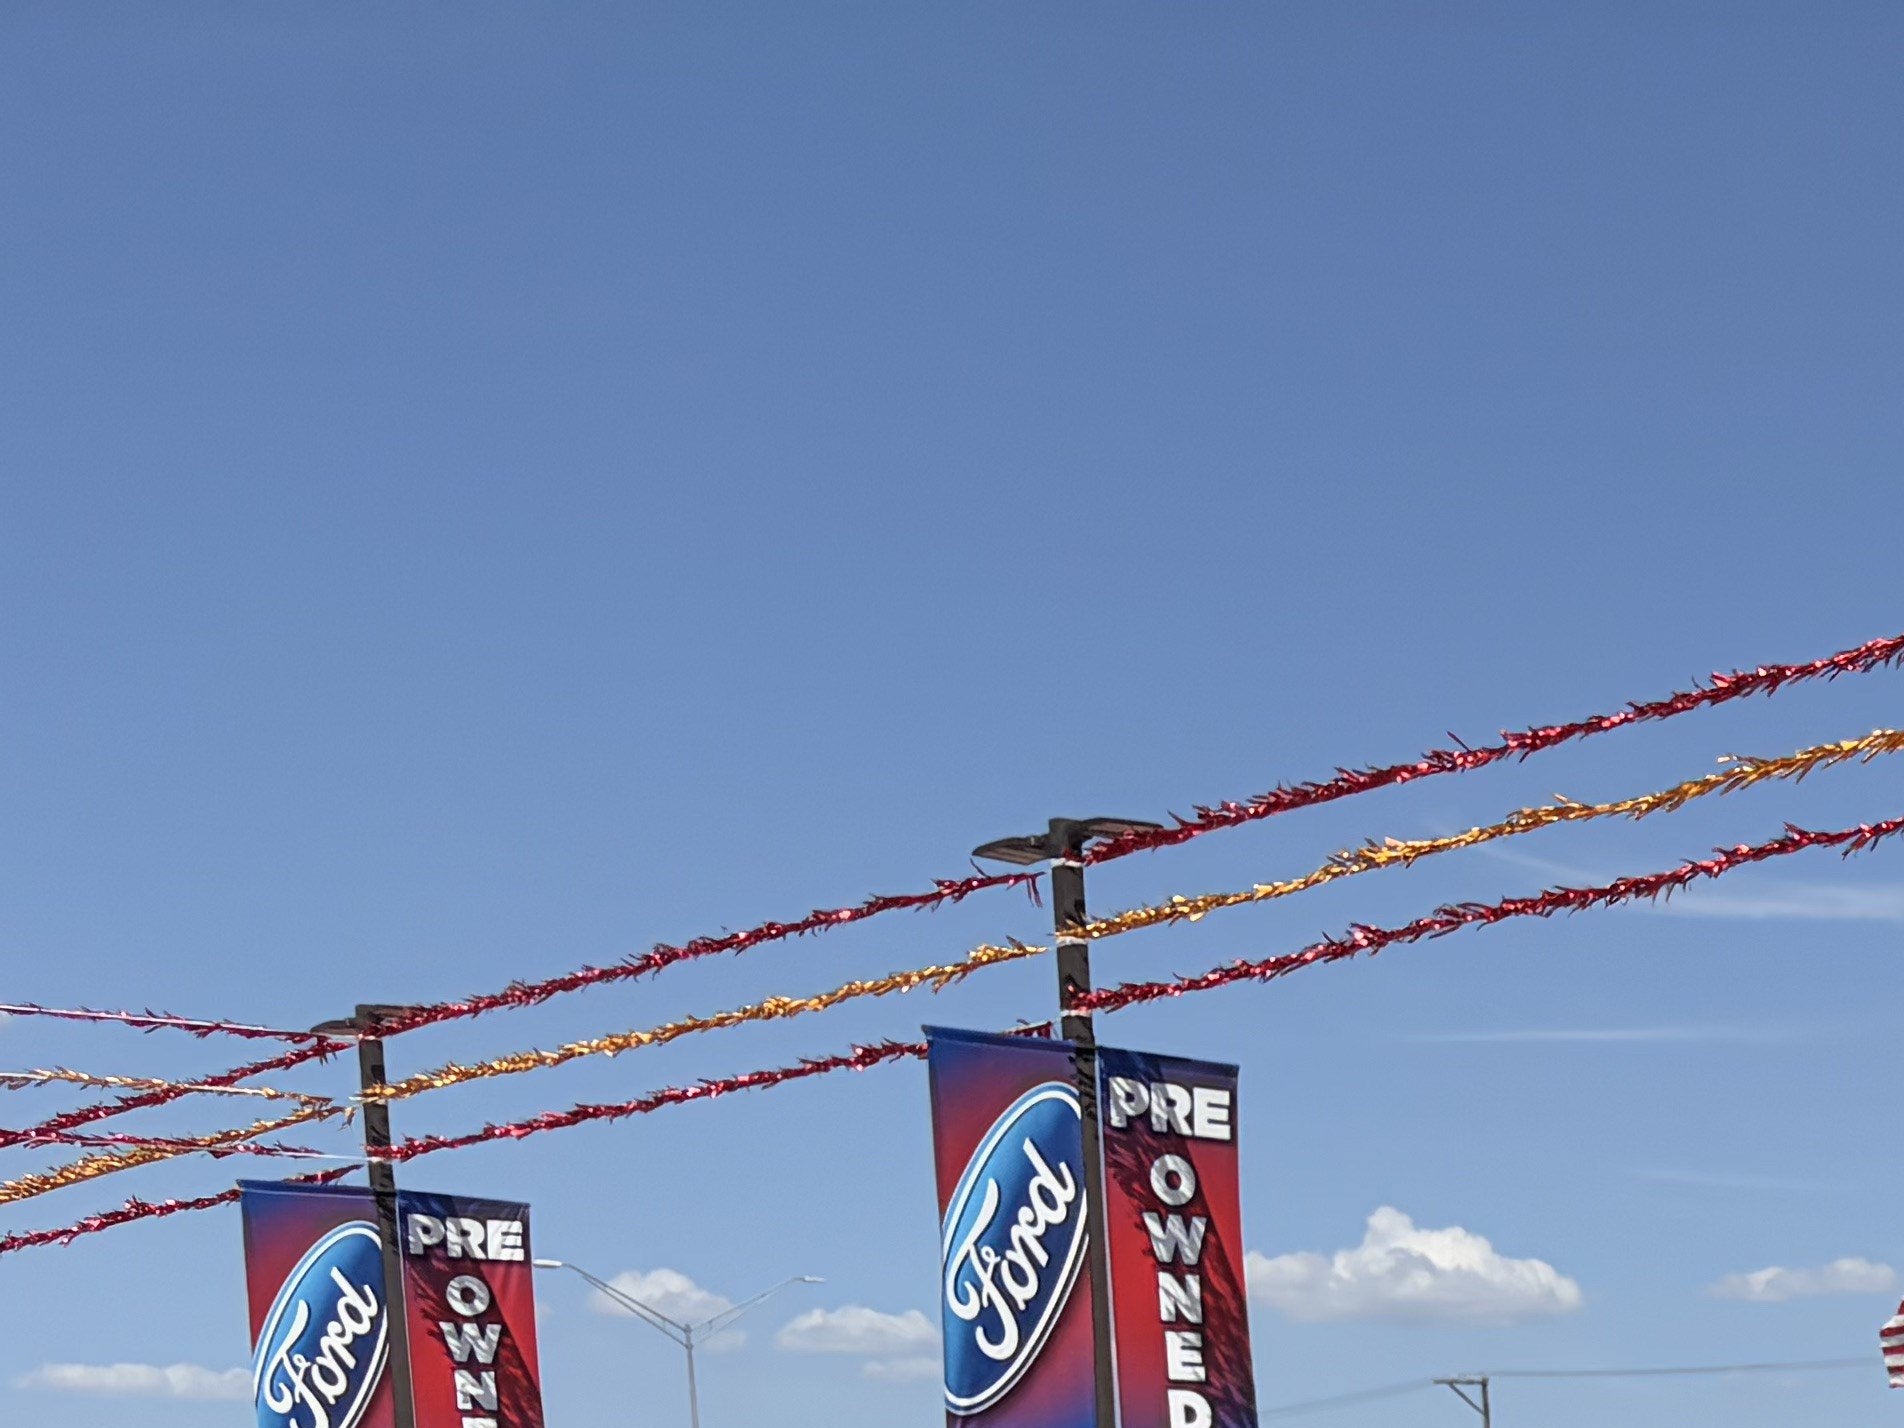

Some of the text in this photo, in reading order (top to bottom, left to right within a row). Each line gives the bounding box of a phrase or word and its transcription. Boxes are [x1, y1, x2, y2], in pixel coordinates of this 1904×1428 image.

[1109, 1076, 1232, 1141] PRE
[407, 1212, 525, 1262] PRE
[946, 1137, 1077, 1361] Ford
